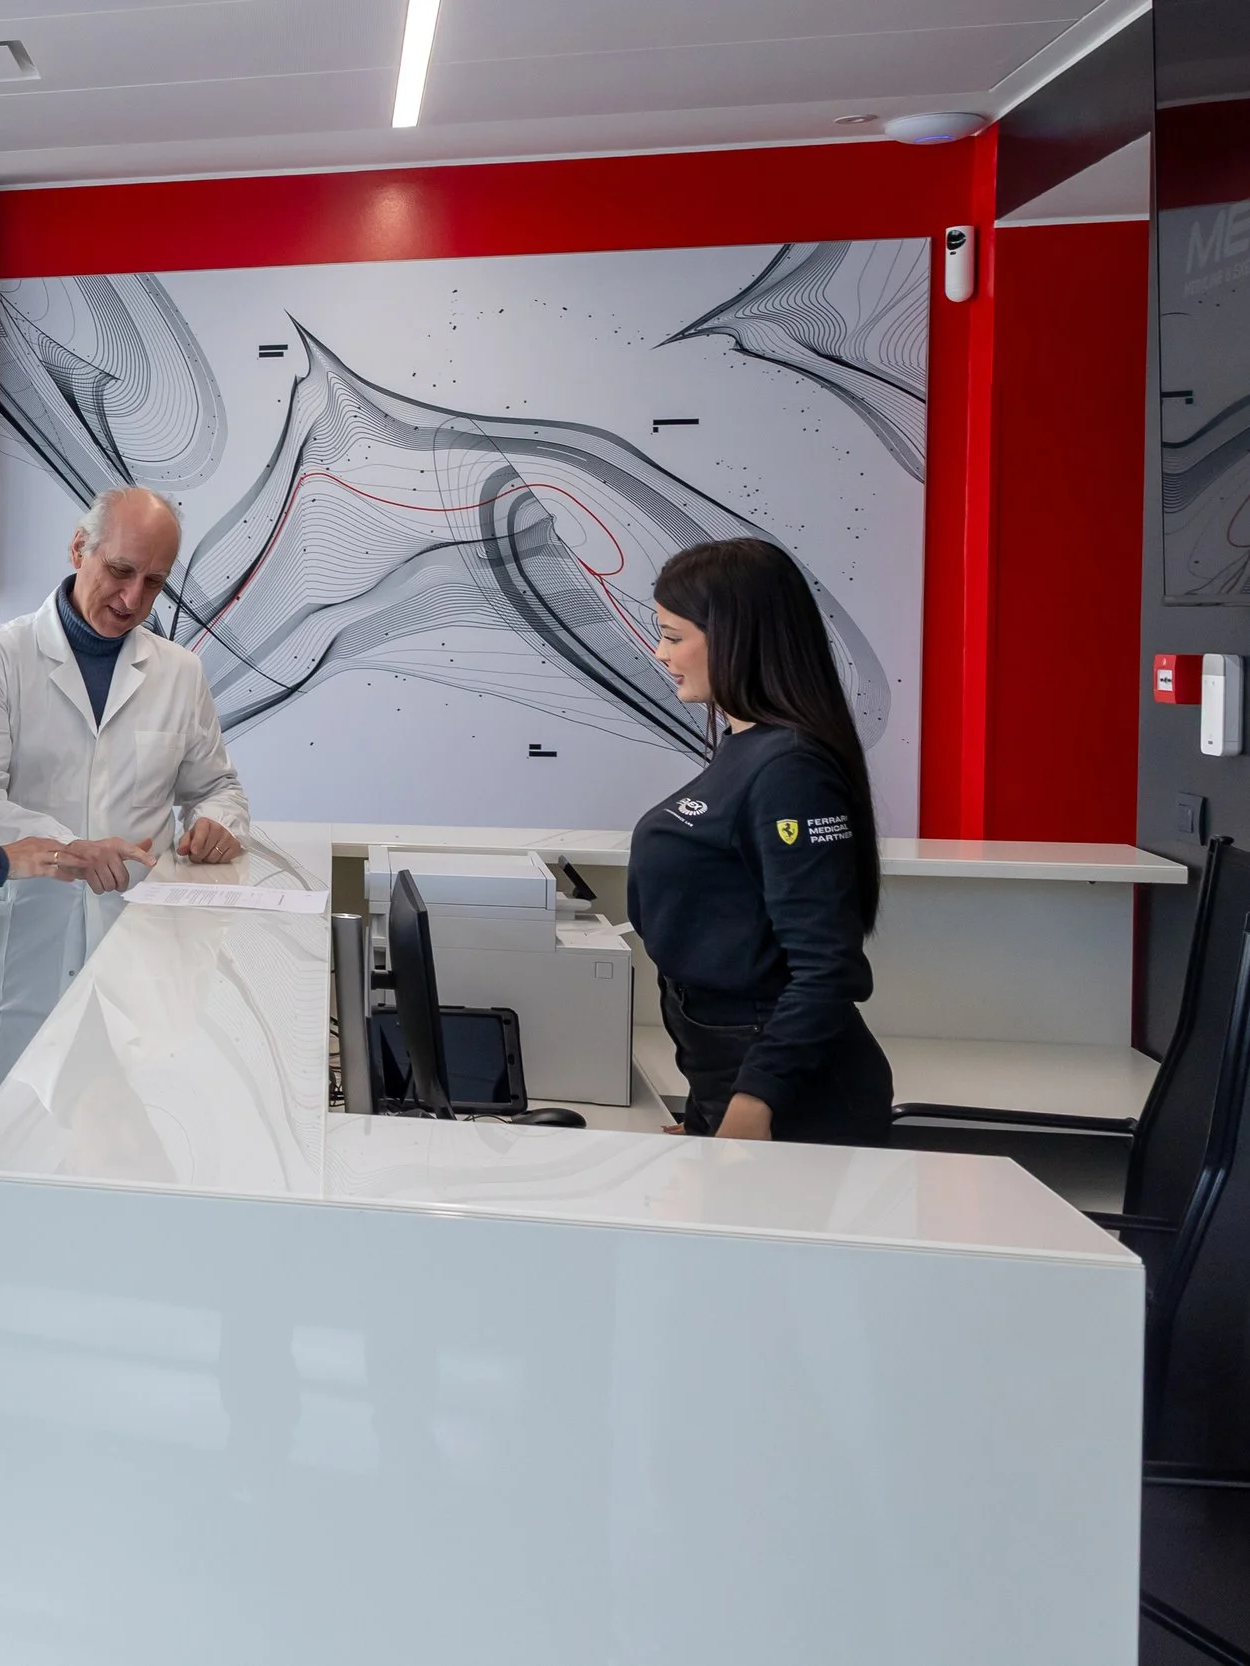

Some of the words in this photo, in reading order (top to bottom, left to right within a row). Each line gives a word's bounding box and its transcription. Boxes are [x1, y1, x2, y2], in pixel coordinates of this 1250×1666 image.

[807, 815, 848, 827] FERRARI
[808, 823, 849, 835] MEDICAL
[810, 831, 853, 844] PARTNER
